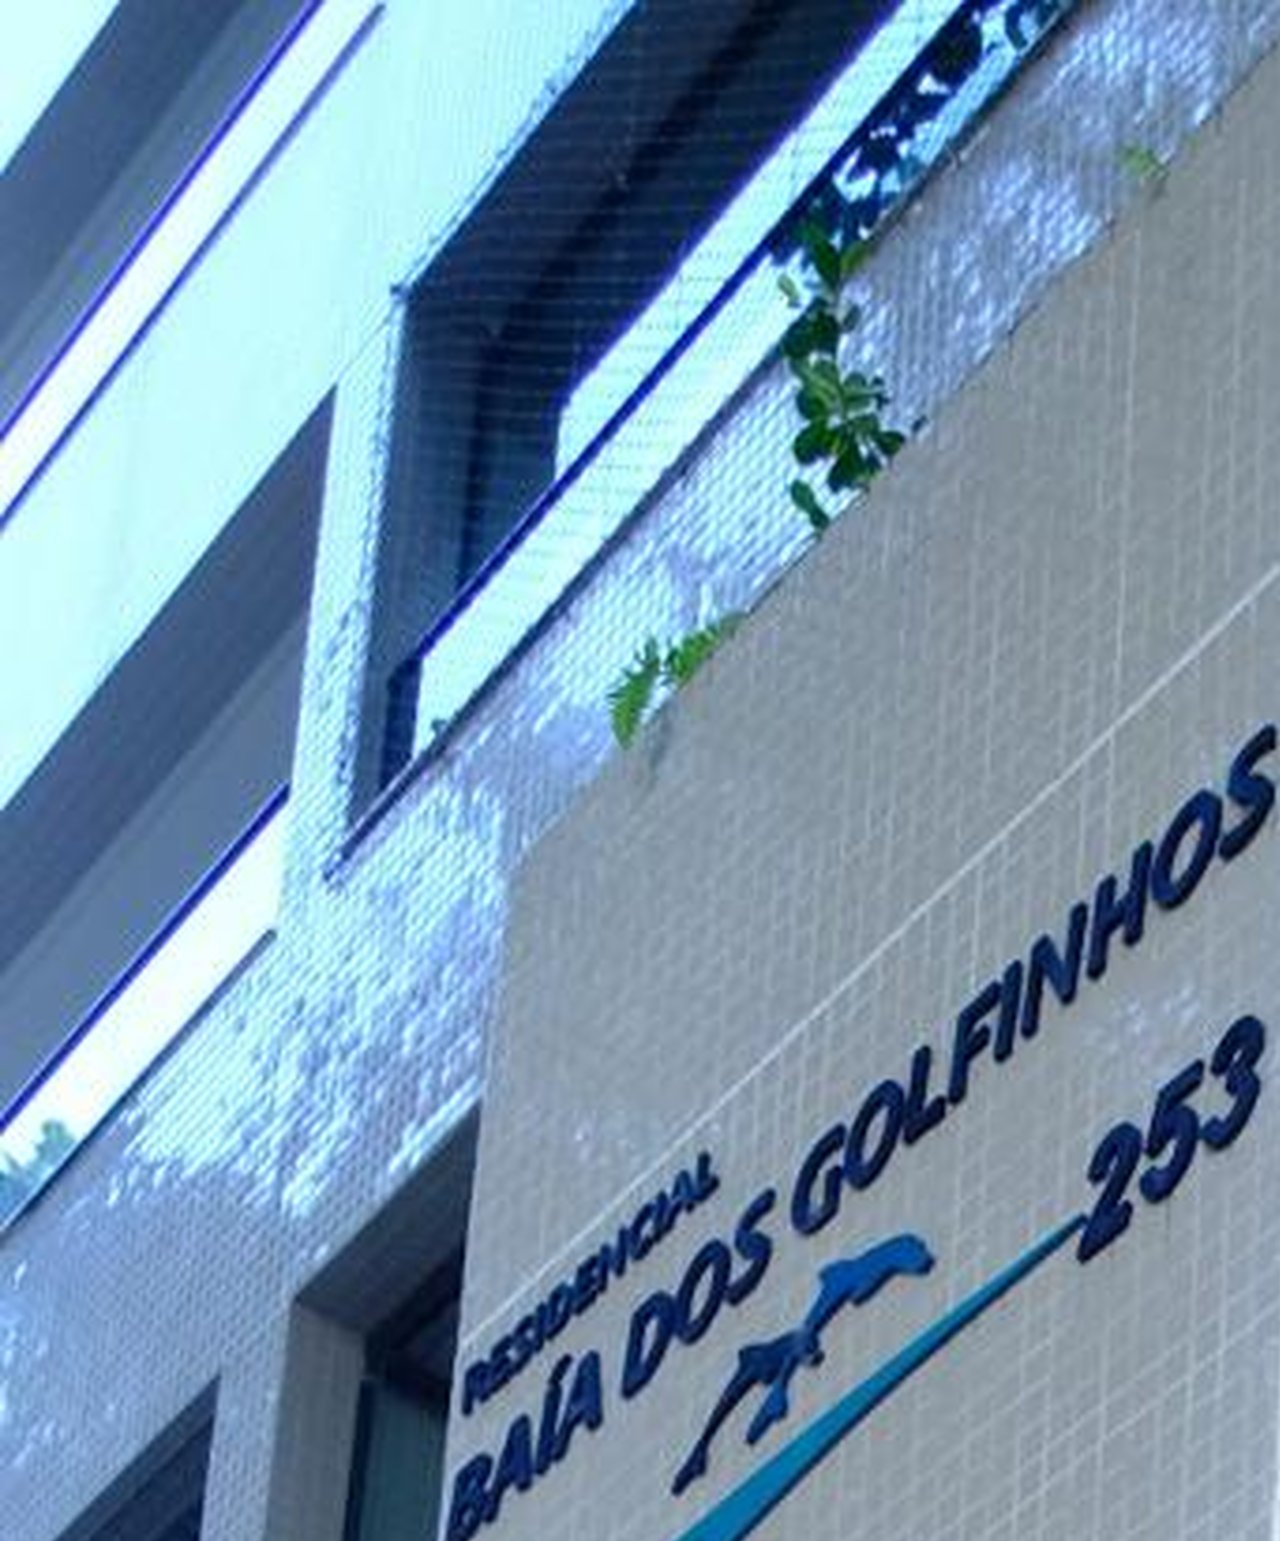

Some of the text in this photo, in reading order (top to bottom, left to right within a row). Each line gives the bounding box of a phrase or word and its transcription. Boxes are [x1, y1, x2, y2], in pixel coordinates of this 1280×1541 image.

[620, 1189, 775, 1399] DOS
[790, 724, 1277, 1237] GOLFINHOS
[1075, 1013, 1267, 1265] 253
[461, 1151, 719, 1416] RESIDENCIAL
